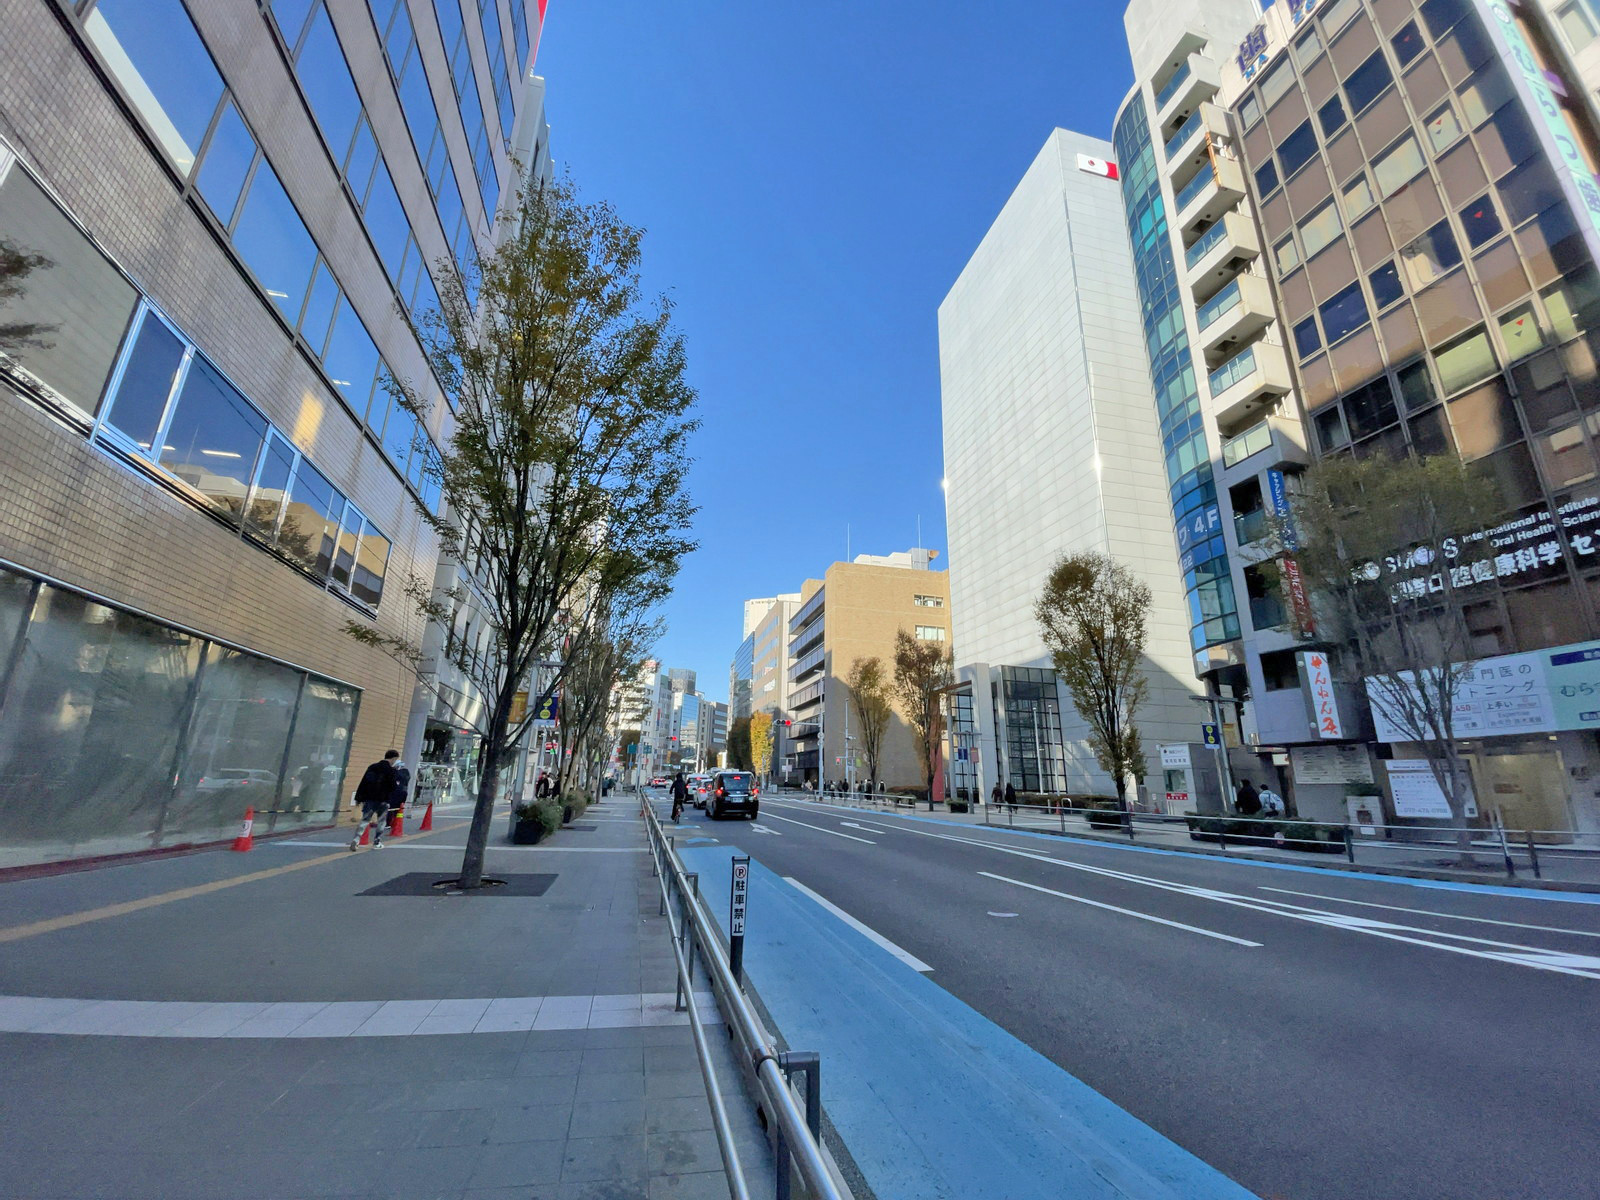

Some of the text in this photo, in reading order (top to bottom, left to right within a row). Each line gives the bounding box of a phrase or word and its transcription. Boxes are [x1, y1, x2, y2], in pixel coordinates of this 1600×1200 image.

[1194, 508, 1218, 533] 4F
[1490, 534, 1515, 549] Oral
[1517, 523, 1556, 542] Health
[733, 880, 745, 934] 駐車禁止
